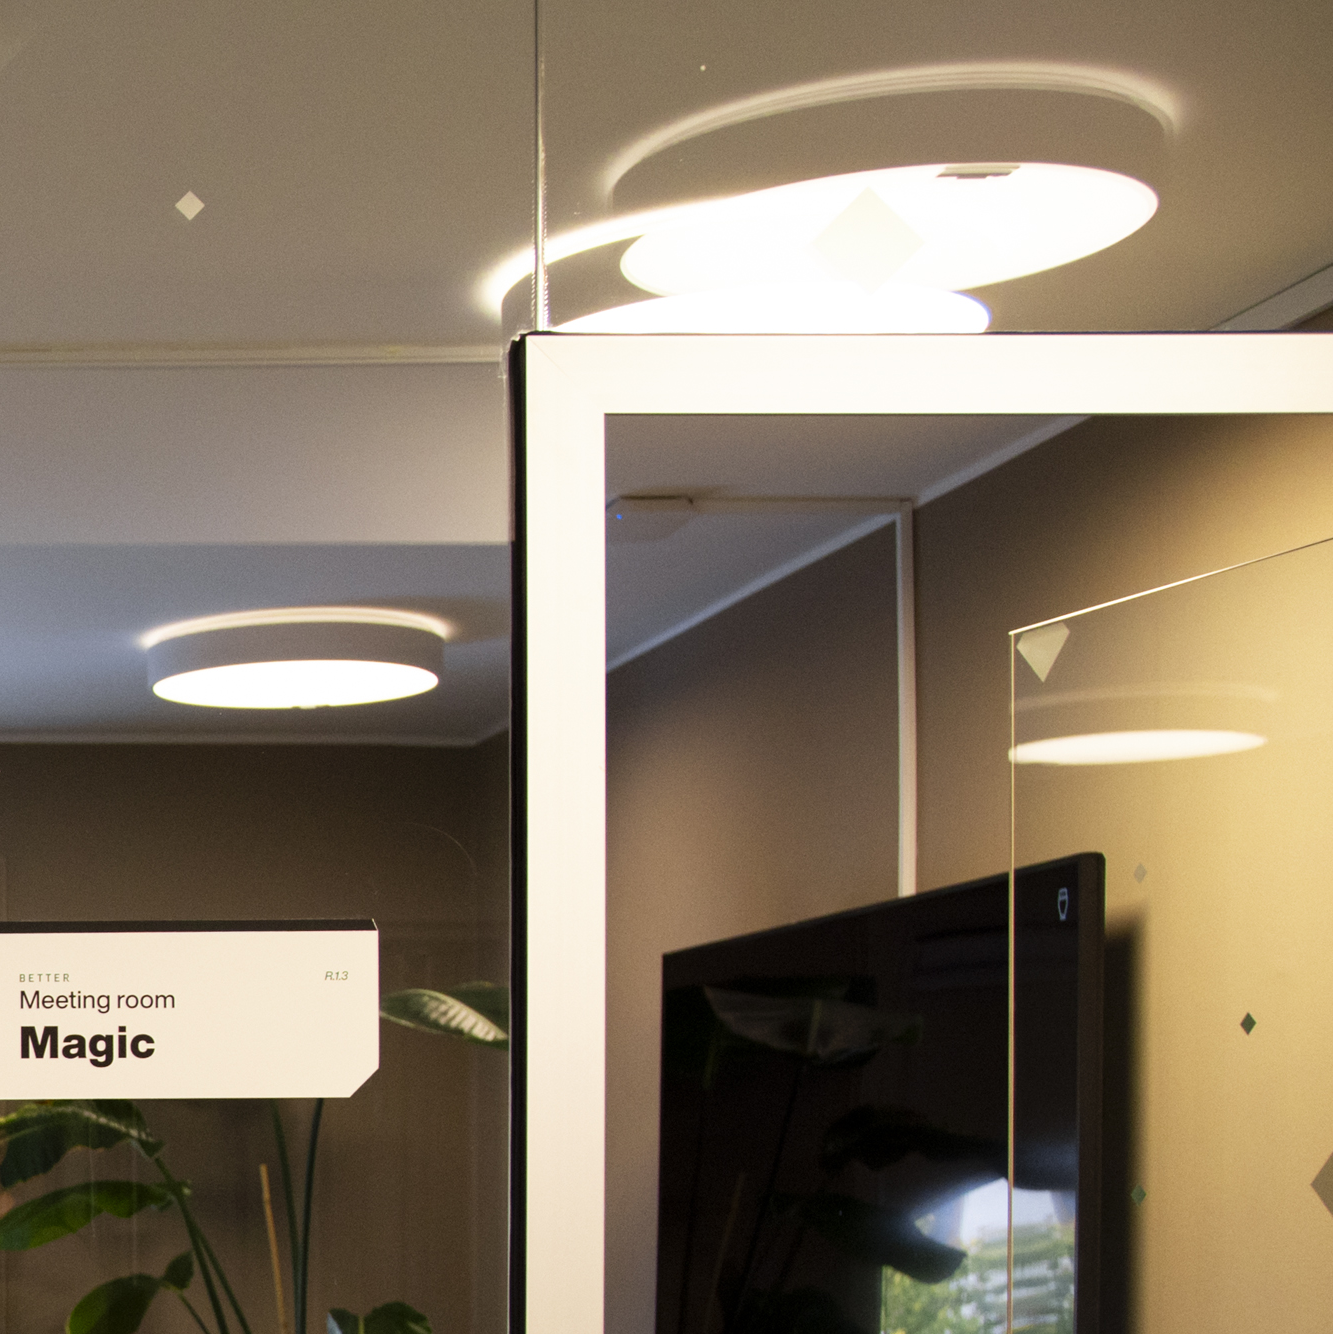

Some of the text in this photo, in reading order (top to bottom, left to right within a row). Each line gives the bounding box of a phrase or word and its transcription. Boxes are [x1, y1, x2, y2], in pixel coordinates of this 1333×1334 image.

[19, 973, 70, 983] BETTER
[20, 990, 175, 1014] Meeting room
[20, 1025, 155, 1068] Magic
